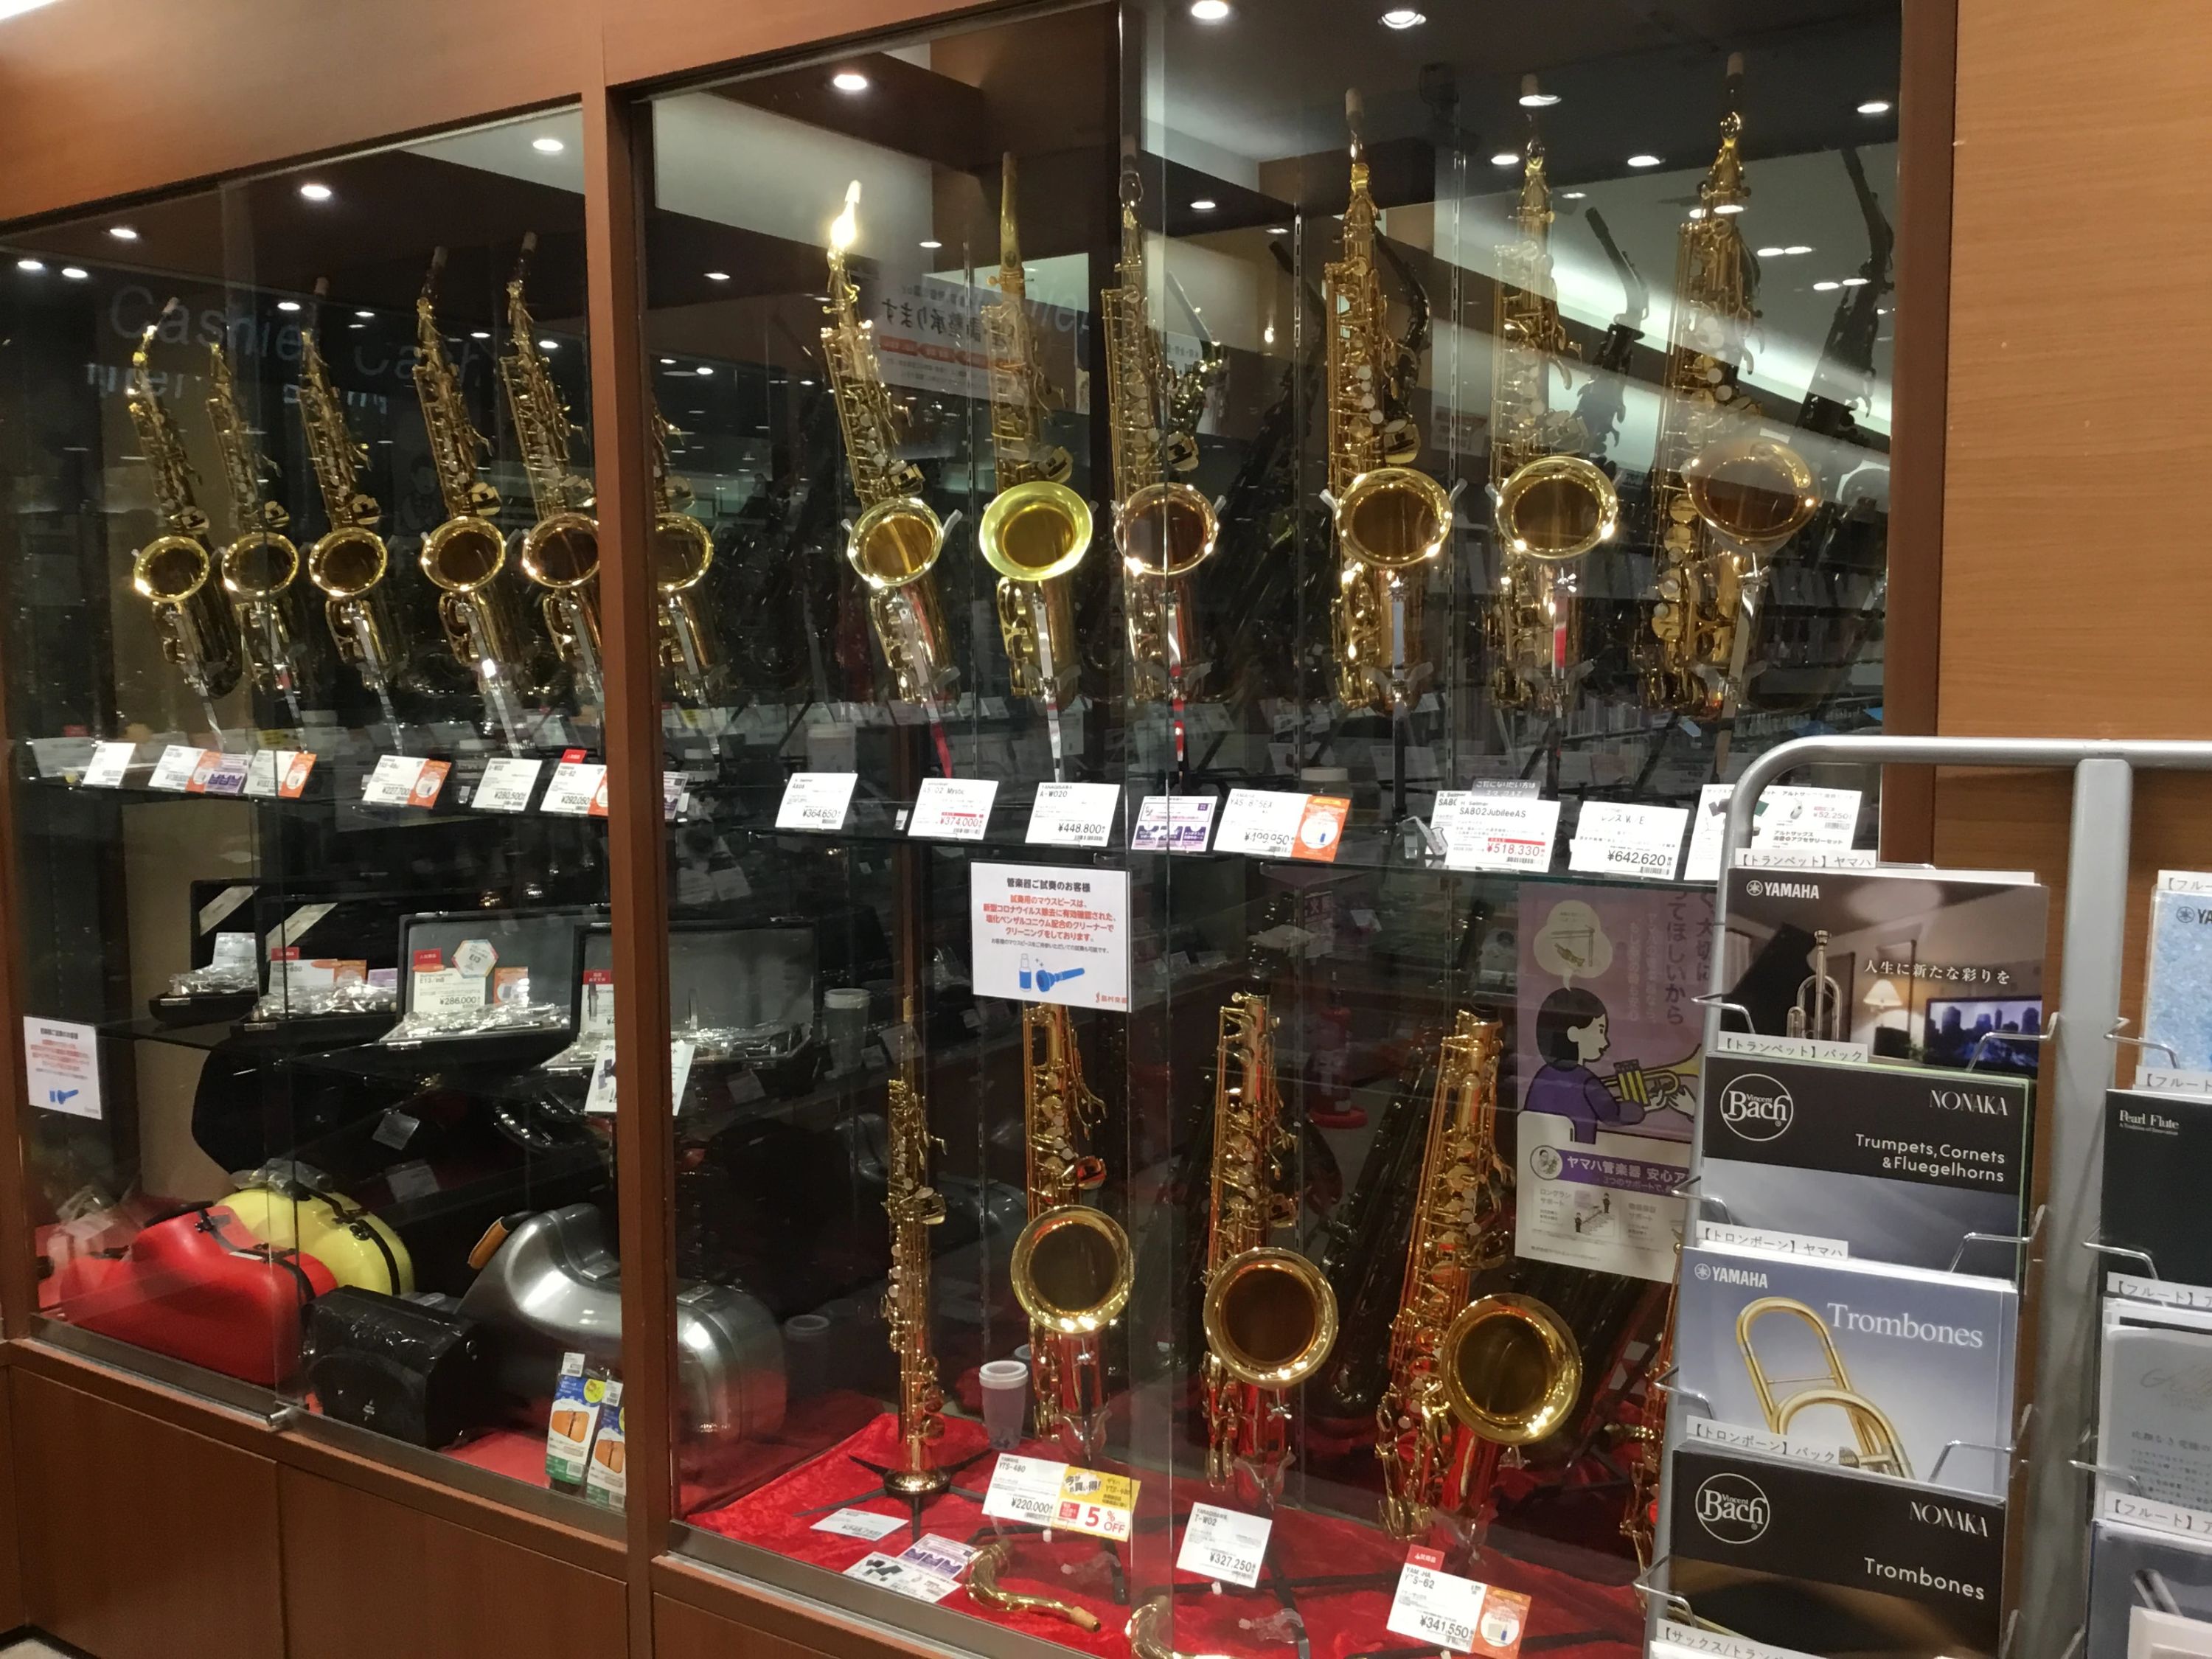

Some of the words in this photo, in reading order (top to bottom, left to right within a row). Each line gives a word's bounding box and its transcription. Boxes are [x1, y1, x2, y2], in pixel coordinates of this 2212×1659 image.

[1607, 849, 1666, 866] ¥642,620
[1006, 877, 1091, 893] 管楽器ご試奏のお客様
[1764, 881, 1820, 900] YAMAHA
[1863, 959, 2011, 985] 人生に新たな彩りを
[1723, 1091, 1791, 1121] Bach
[1746, 1093, 1773, 1103] Vincent
[1929, 1089, 2009, 1117] NONAKA
[2119, 1110, 2146, 1125] Pearl
[2150, 1113, 2180, 1129] Flute
[1567, 1155, 1641, 1178] ヤマハ管楽器
[1540, 1188, 1572, 1199] ロングラン
[1712, 1266, 1769, 1290] YAMAHA
[1826, 1302, 1984, 1349] Trombones
[1698, 1489, 1767, 1525] Bach
[1722, 1493, 1749, 1505] Vincent
[1085, 1506, 1101, 1527] 5
[1107, 1510, 1116, 1521] %
[1104, 1520, 1126, 1534] OFF
[1909, 1501, 1989, 1538] NONAKA
[1210, 1551, 1252, 1572] ¥327,250
[1864, 1557, 1986, 1601] Trombones
[1419, 1615, 1470, 1639] ¥341,550
